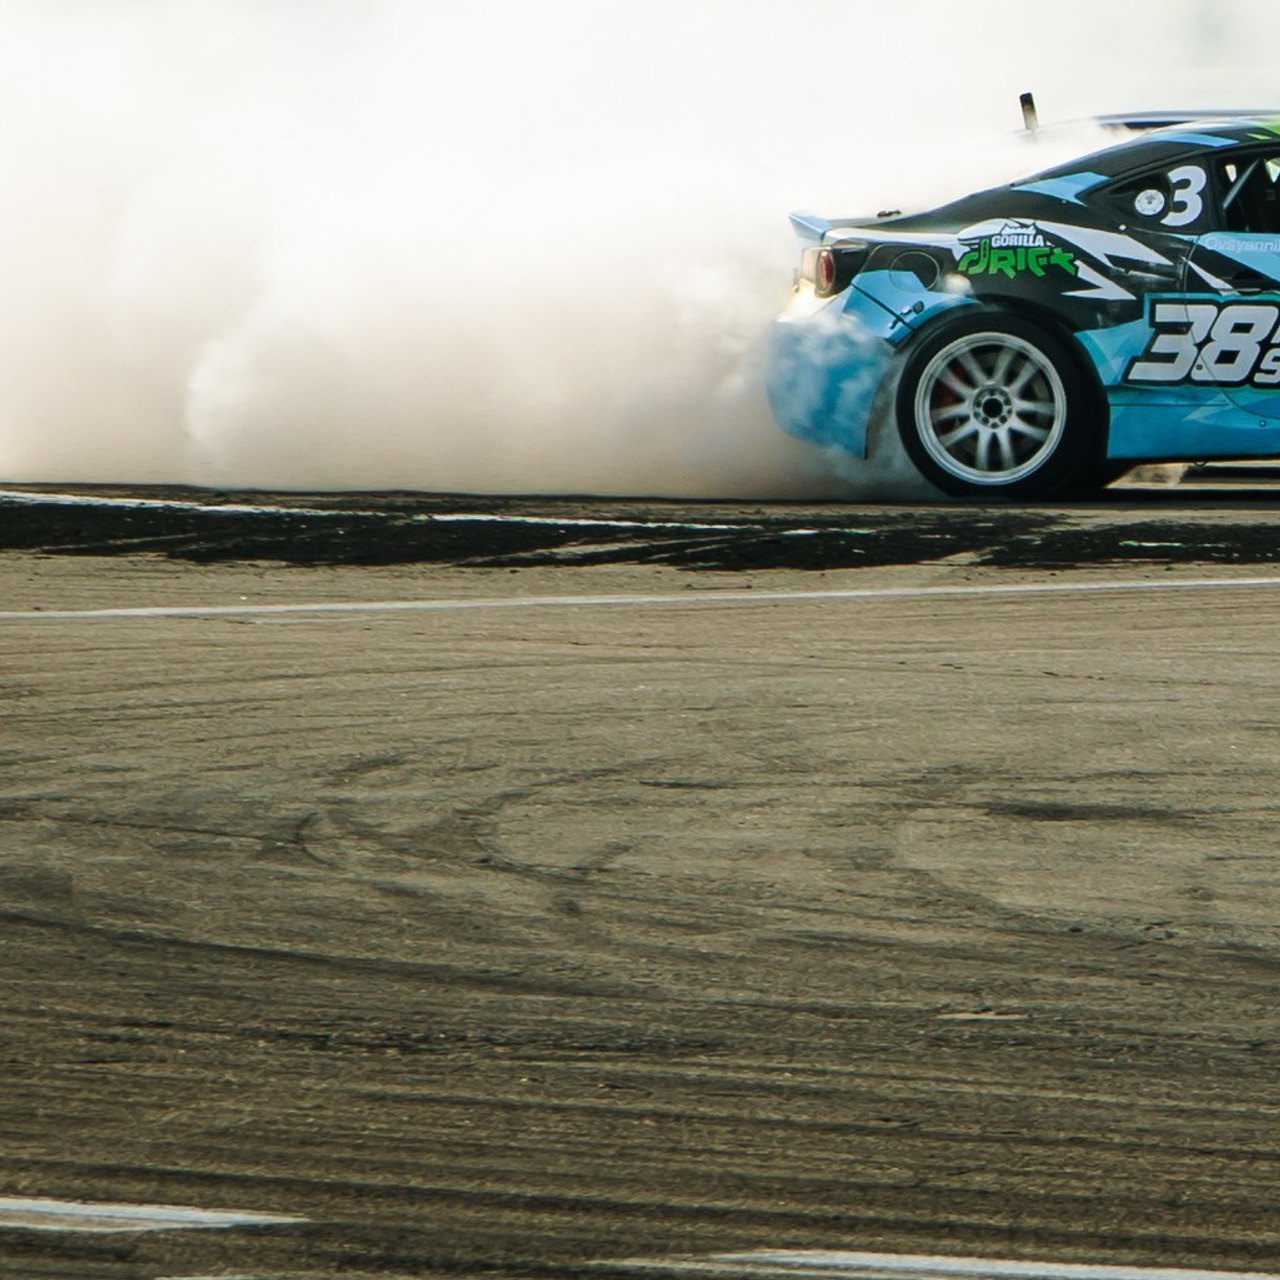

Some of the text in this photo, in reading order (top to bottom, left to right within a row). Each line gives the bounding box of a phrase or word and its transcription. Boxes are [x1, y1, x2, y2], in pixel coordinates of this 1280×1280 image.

[1160, 165, 1207, 227] 3
[991, 235, 1044, 247] GORILLA
[1128, 304, 1279, 381] 38
